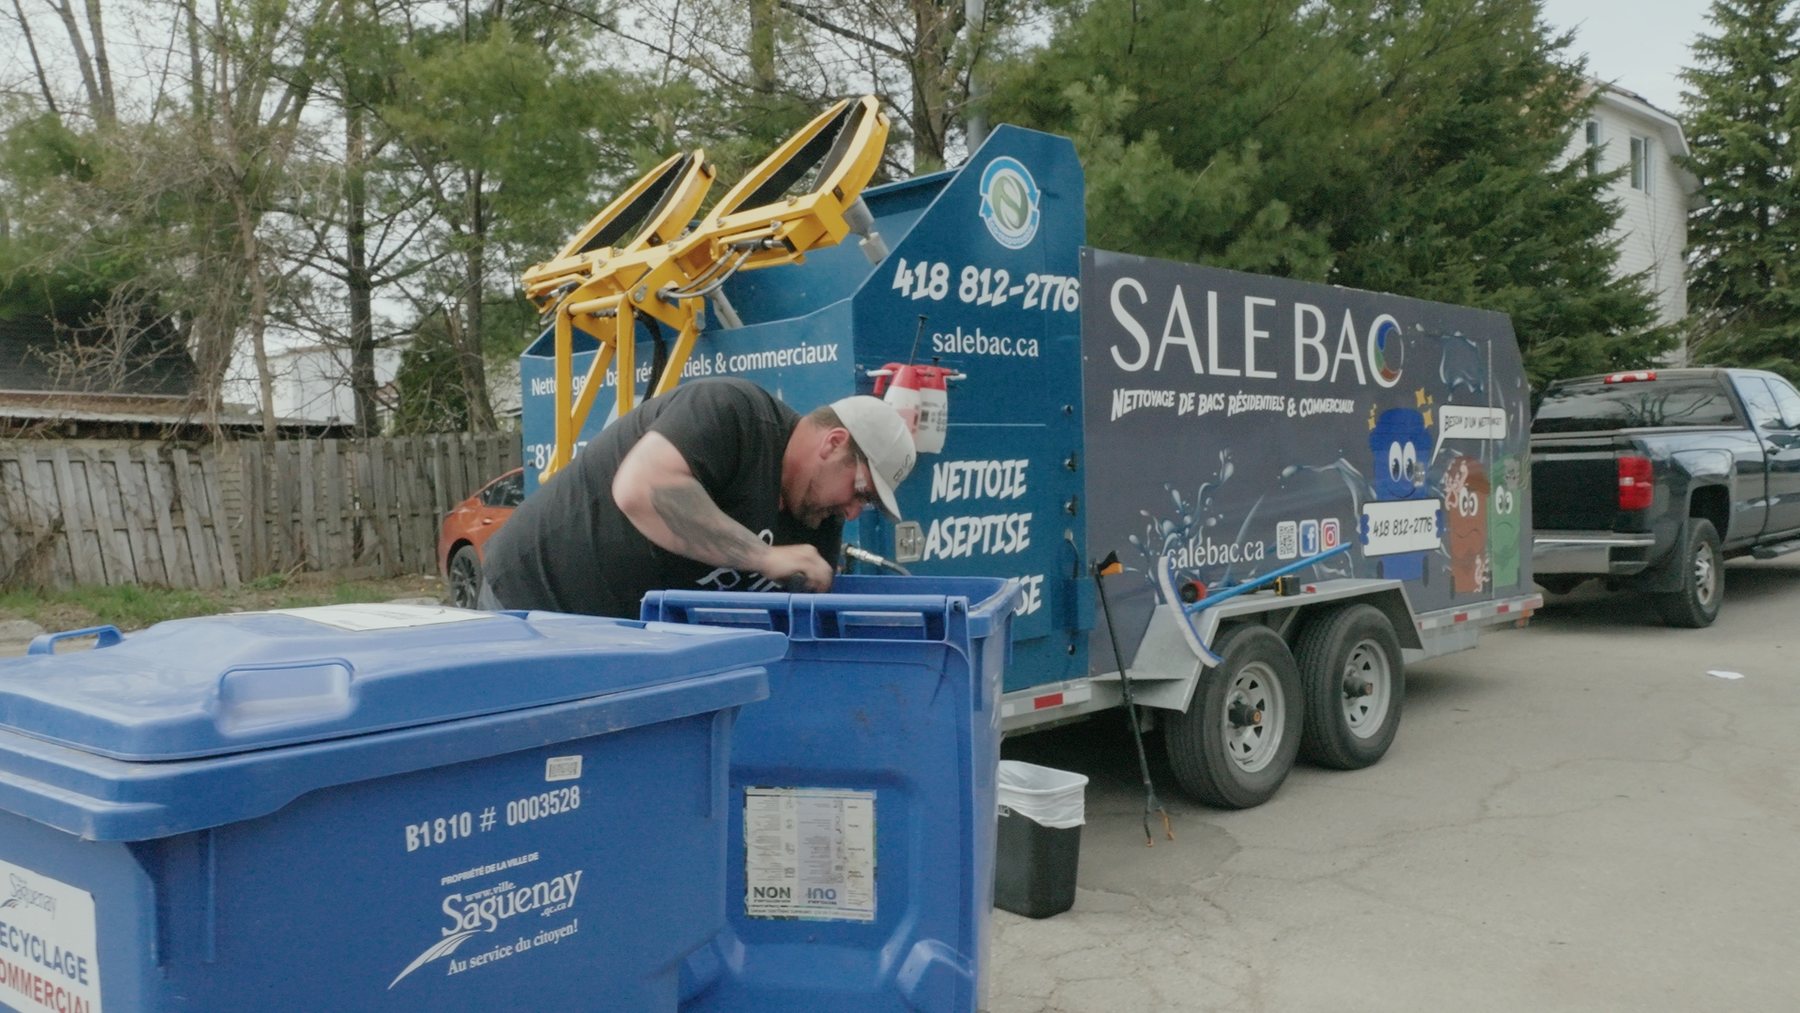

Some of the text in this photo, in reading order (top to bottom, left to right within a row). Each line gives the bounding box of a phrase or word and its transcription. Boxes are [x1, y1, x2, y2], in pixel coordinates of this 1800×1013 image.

[892, 258, 1080, 312] 418 812-2776
[932, 326, 1039, 357] salebac.ca
[1110, 277, 1277, 379] SALE
[715, 352, 727, 374] &
[729, 342, 839, 373] commerciaux
[1111, 388, 1355, 422] NETTOYAGE DE BACS RÉSIDENTIELS & COMMERCIAUX
[930, 459, 1029, 503] NETTOIE
[923, 512, 1032, 561] ASEPTISE
[1373, 516, 1432, 537] 418 812-2776
[1167, 536, 1264, 570] salebac.ca
[406, 785, 581, 852] B1810 # 0003528
[441, 852, 539, 886] PROPRIÉTÉ DE LA VILLE DE
[441, 870, 583, 937] Saguenay
[753, 886, 791, 899] NON
[0, 921, 89, 986] ECYCLAGE
[448, 918, 579, 976] Au service du citoyen!
